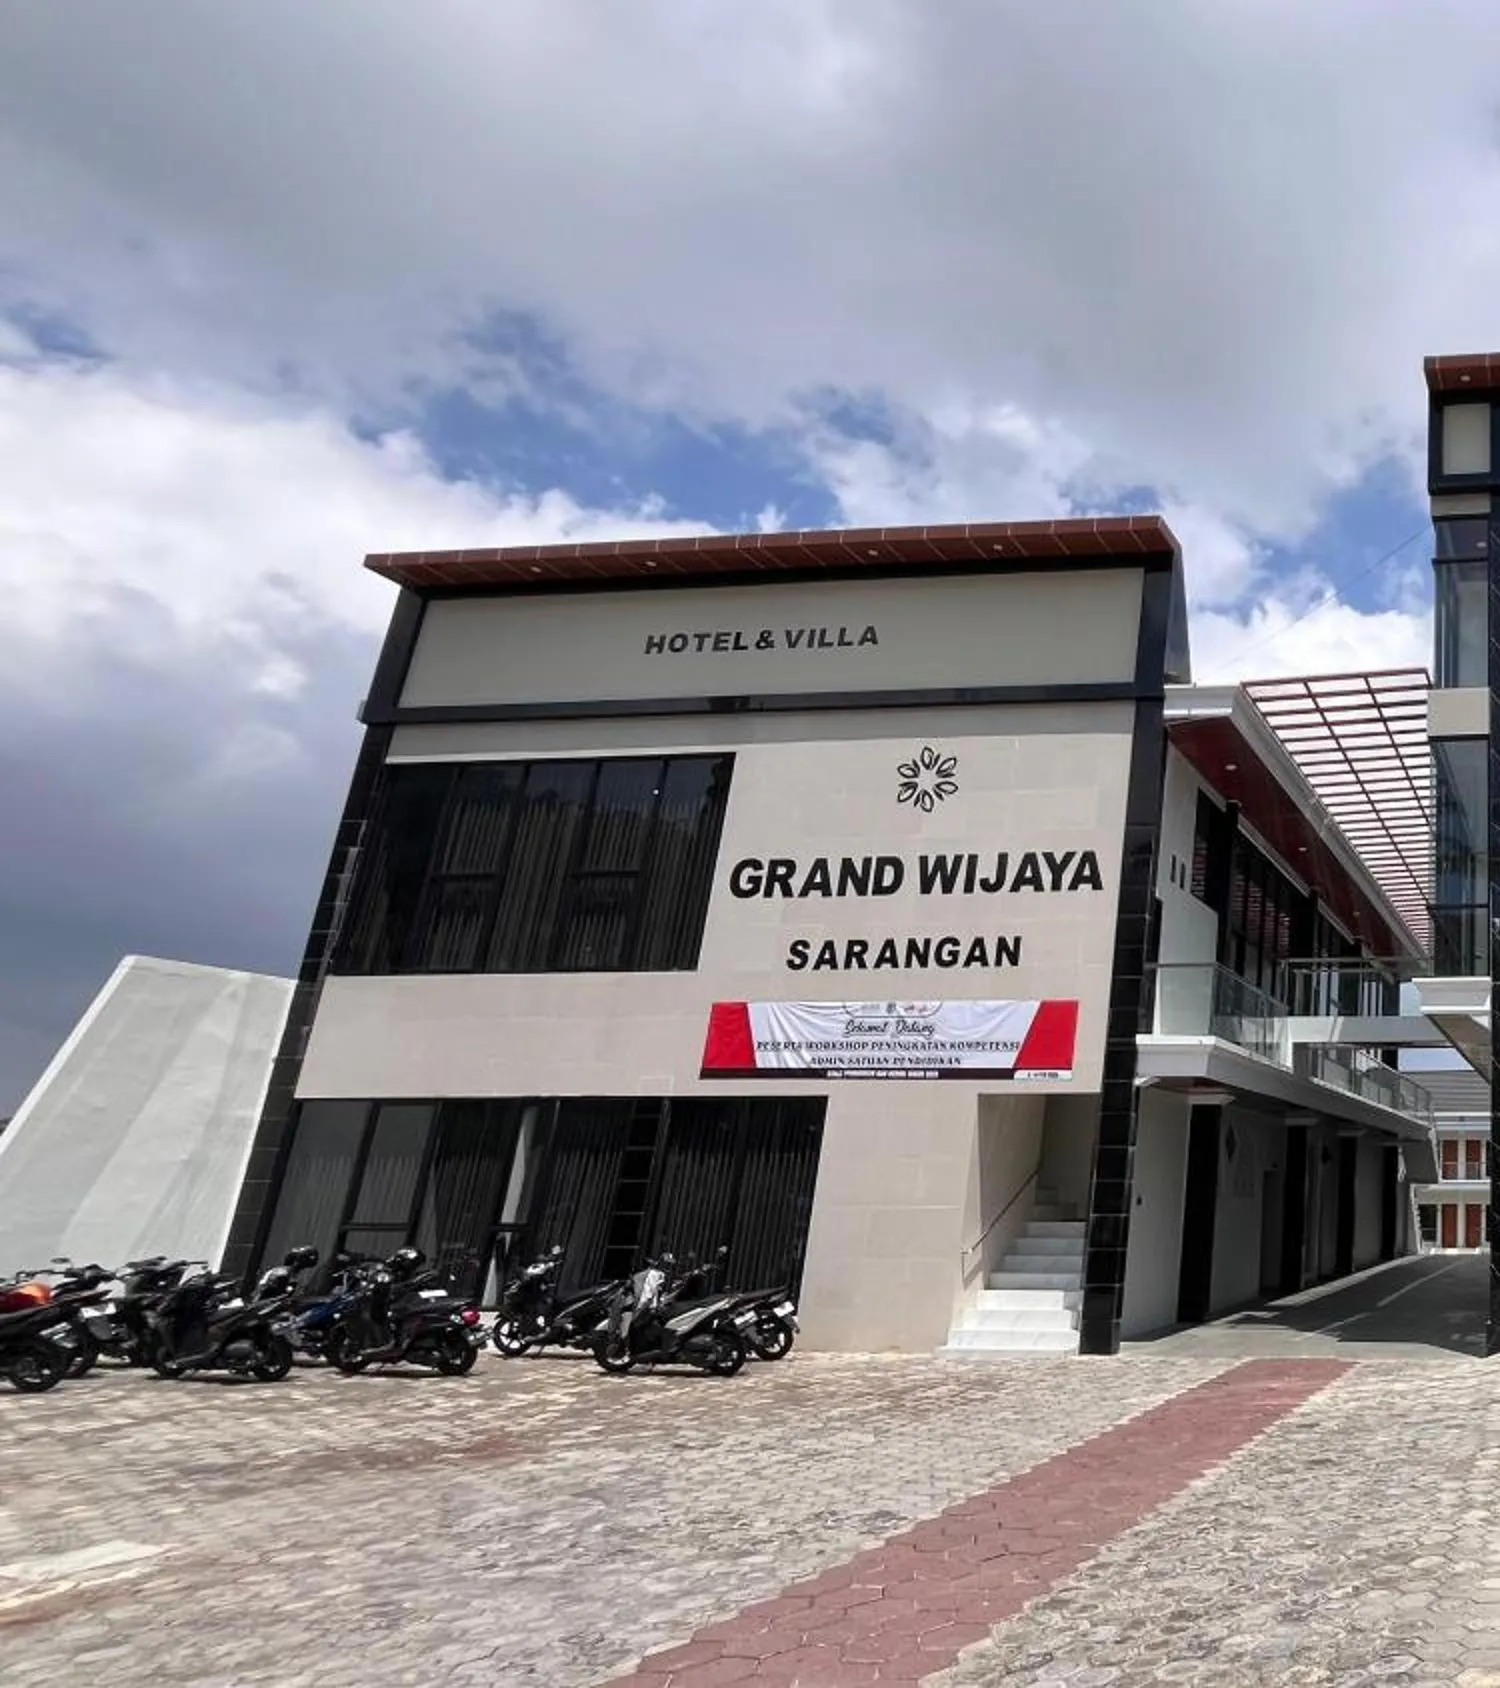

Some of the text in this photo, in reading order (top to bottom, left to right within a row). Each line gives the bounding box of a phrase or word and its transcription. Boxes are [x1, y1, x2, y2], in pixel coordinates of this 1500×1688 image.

[729, 851, 1104, 899] GRAND WIJAYA
[786, 936, 1023, 971] SARANGAN
[805, 1041, 869, 1051] WORKSHOP
